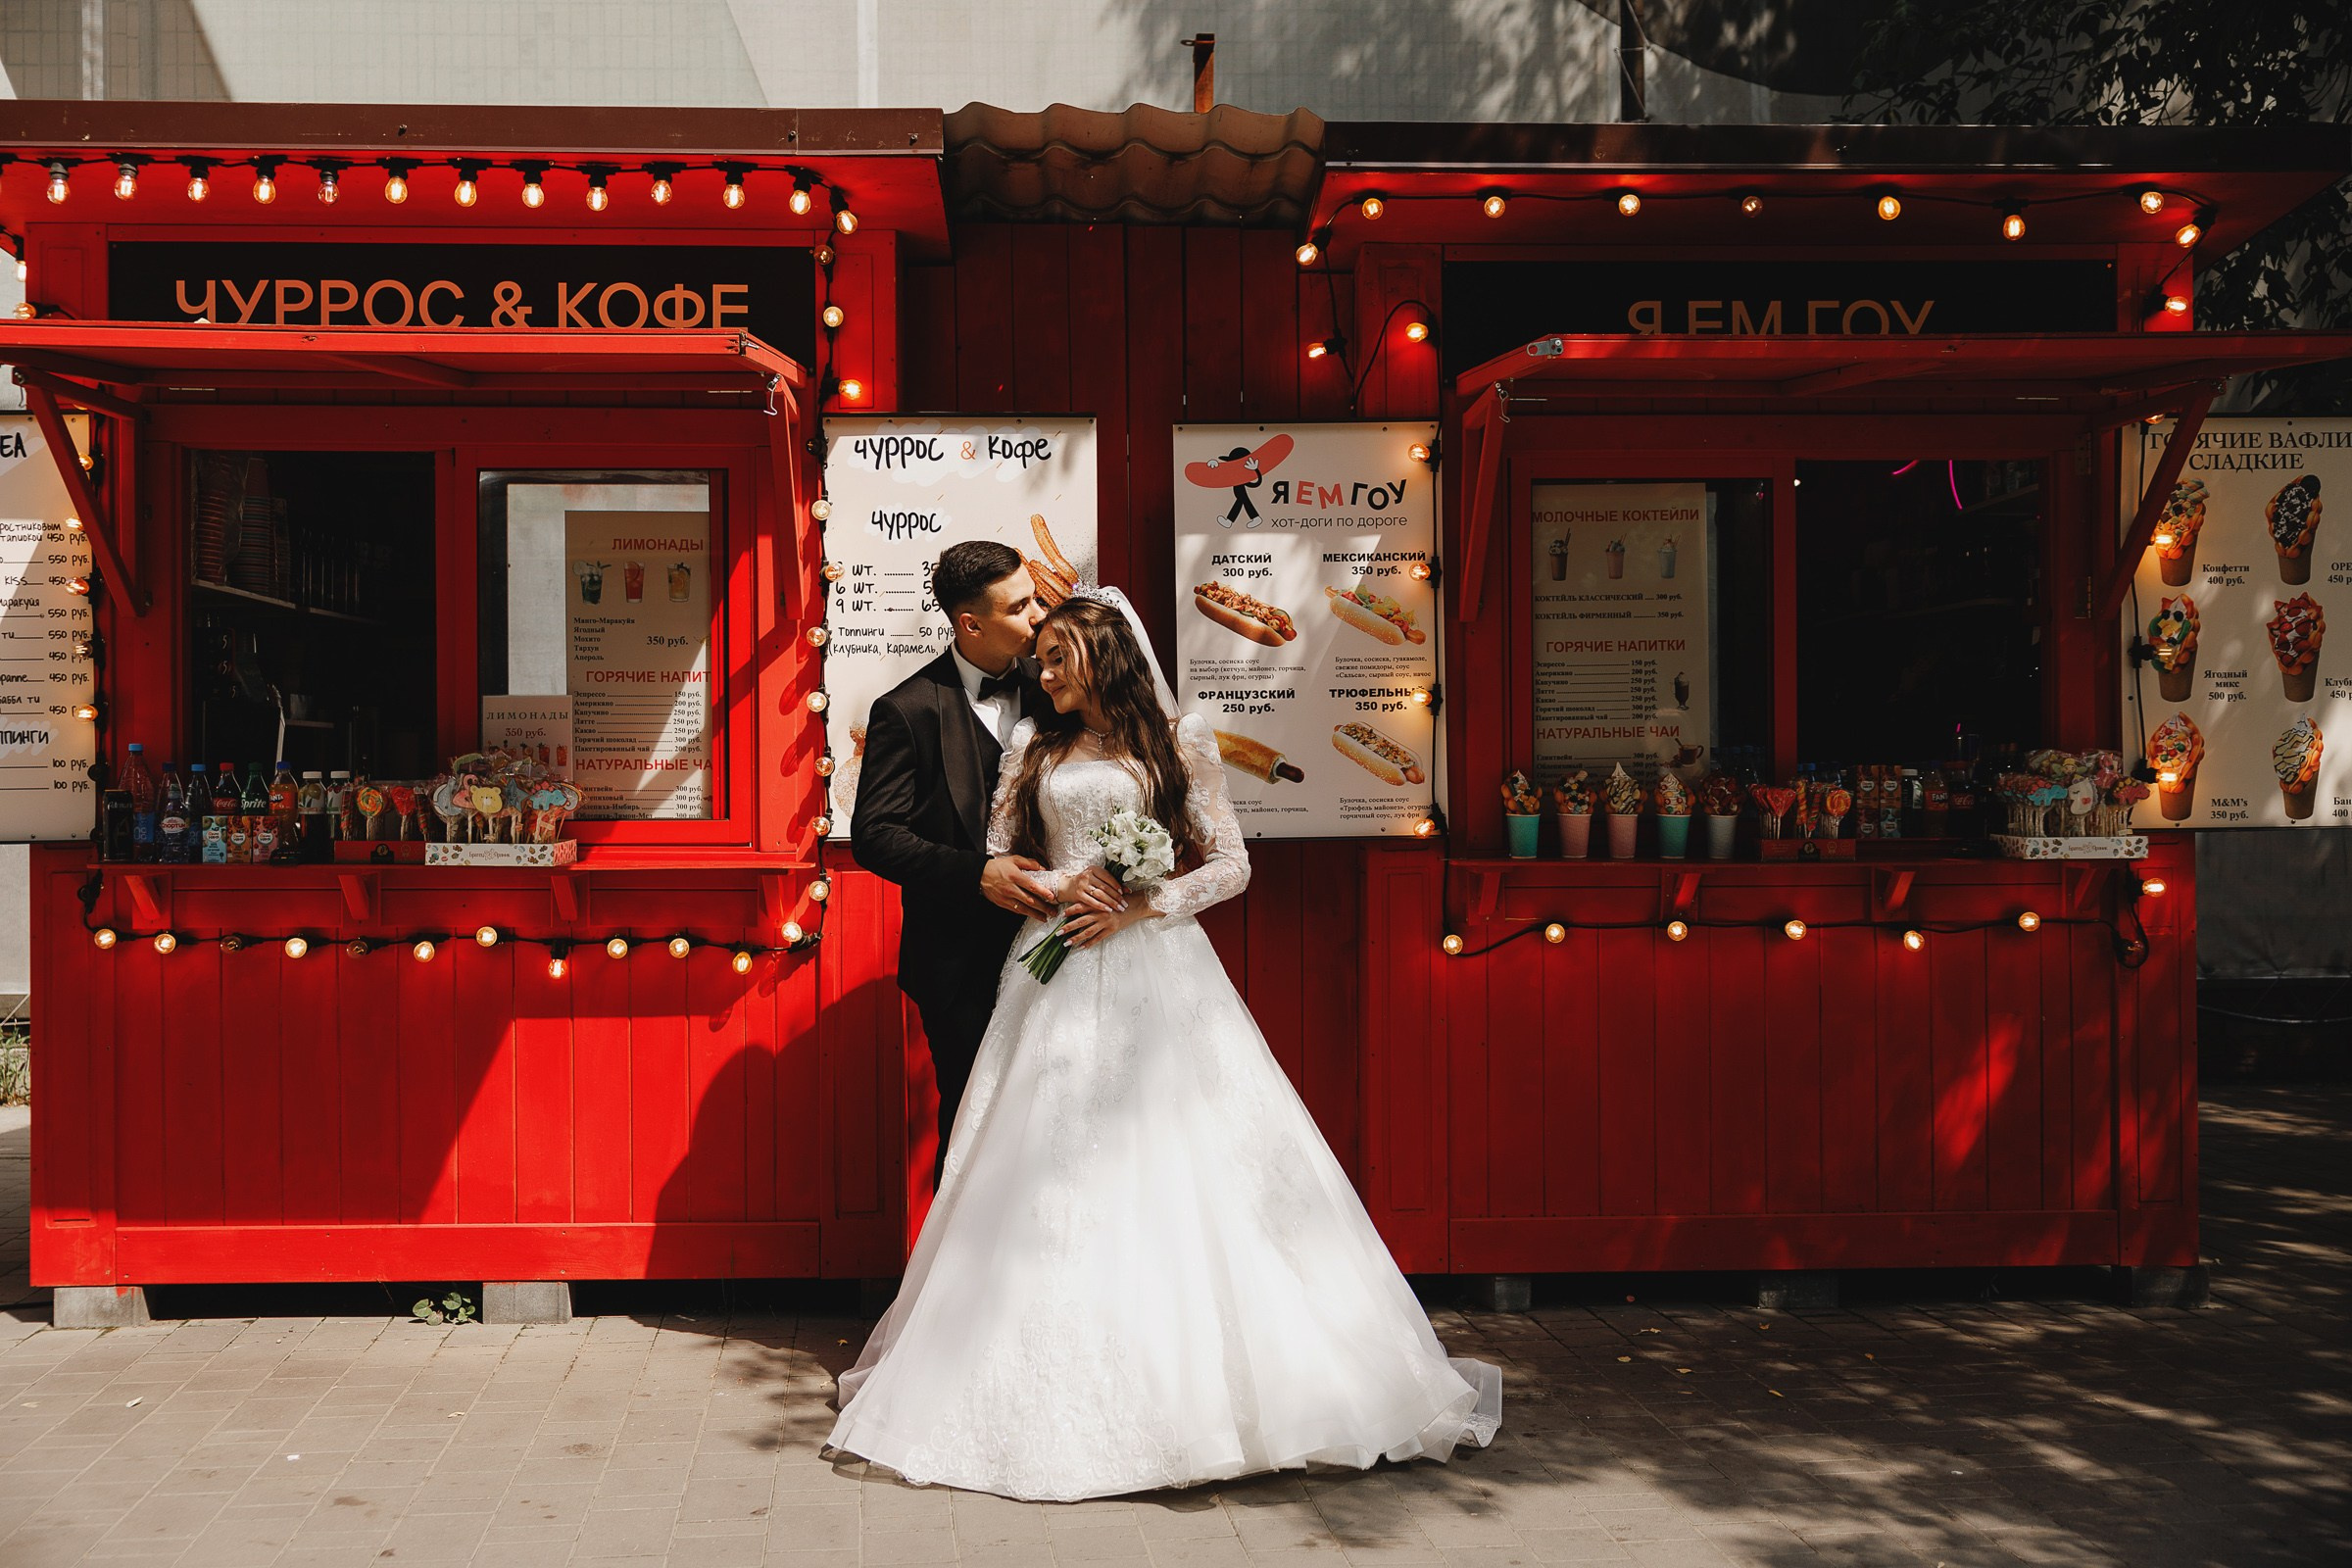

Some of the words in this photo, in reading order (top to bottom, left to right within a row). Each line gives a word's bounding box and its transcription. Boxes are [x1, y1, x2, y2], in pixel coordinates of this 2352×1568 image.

[175, 278, 465, 329] ЧУРРОС
[491, 279, 532, 329] &
[558, 279, 749, 331] КОФЕ
[1628, 299, 1662, 335] Я
[1688, 299, 1782, 335] ЕМ
[1806, 299, 1936, 335] ГОУ
[2149, 432, 2263, 449] ГЯЧИЕ
[2269, 432, 2352, 448] ВАФЛИ
[960, 441, 976, 460] &
[2189, 454, 2304, 472] СЛАДКИЕ
[1350, 479, 1406, 510] ГОУ
[1536, 511, 1618, 522] МОЛОЧНЫЕ
[1623, 507, 1699, 521] КОКТЕЙЛИ
[1272, 518, 1332, 529] хот-доги
[1337, 517, 1353, 526] по
[1357, 517, 1407, 529] дороге
[47, 533, 65, 542] 450
[612, 539, 703, 553] ЛИМОНАДЫ
[48, 555, 67, 564] 550
[1212, 553, 1271, 564] ДАТСКИЙ
[1323, 551, 1425, 562] МЕКСИКАНСКИЙ
[1249, 567, 1272, 578] руб.
[1377, 565, 1401, 576] руб.
[2203, 564, 2249, 574] Конфетти
[49, 576, 67, 586] 450
[2227, 576, 2244, 586] руб.
[2328, 574, 2343, 583] 450
[836, 599, 844, 613] 9
[48, 609, 67, 617] 550
[49, 630, 67, 639] 550
[919, 627, 932, 637] 50
[647, 636, 664, 645] 350
[668, 636, 688, 647] руб.
[1546, 641, 1613, 653] ГОРЯЧИЕ
[1618, 640, 1685, 651] НАПИТКИ
[49, 652, 67, 661] 450
[49, 673, 67, 682] 450
[586, 671, 656, 682] ГОРЯЧИЕ
[1199, 688, 1295, 701] ФРАНЦУЗСКИЙ
[1329, 686, 1425, 699] ТРЮФЕЛЬНЫ
[2228, 692, 2246, 702] руб.
[49, 706, 67, 714] 450
[1223, 704, 1245, 712] 250
[1250, 704, 1274, 714] руб.
[1355, 702, 1377, 710] 350
[1382, 702, 1406, 711] руб.
[486, 711, 568, 720] ЛИМОНАДЫ
[574, 709, 609, 717] Капучино
[525, 727, 546, 739] руб.
[1537, 726, 1644, 739] НАТУРАЛЬНЫЕ
[1650, 726, 1679, 737] ЧАИ
[574, 736, 604, 745] Горячий
[53, 759, 66, 767] 100
[576, 759, 688, 770] НАТУРАЛЬНЫЕ
[54, 780, 67, 789] 100
[240, 798, 267, 810] Sprite
[2211, 810, 2227, 819] 350
[2230, 810, 2248, 821] руб.
